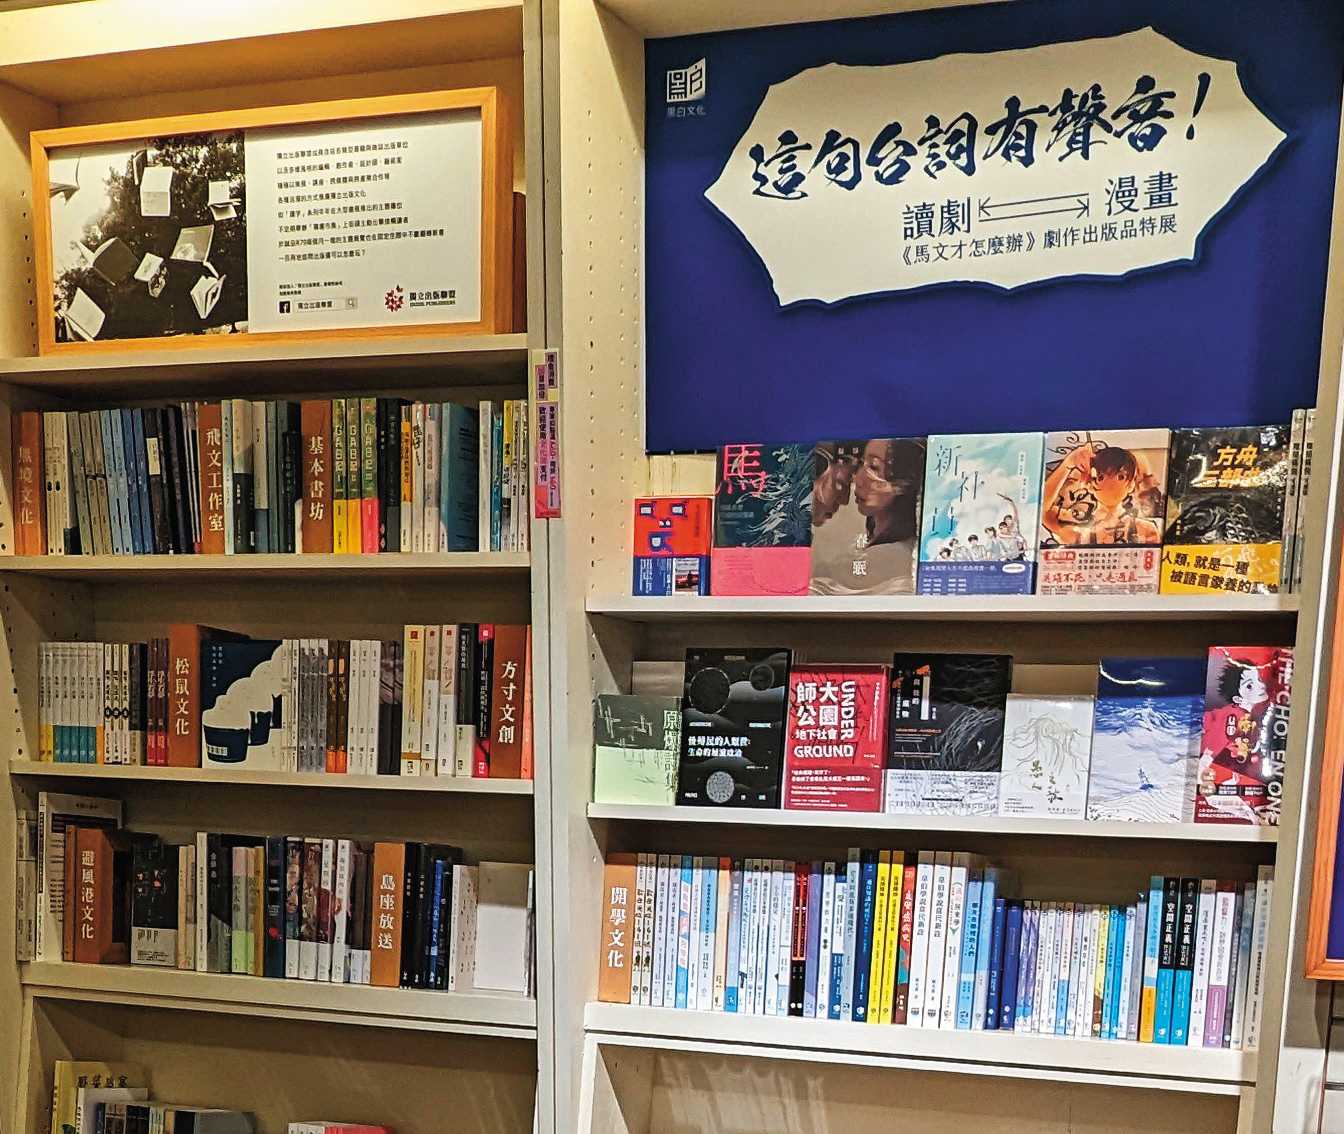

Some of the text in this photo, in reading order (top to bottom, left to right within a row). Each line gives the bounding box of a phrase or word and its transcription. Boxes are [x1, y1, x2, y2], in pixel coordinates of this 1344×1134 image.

[901, 196, 971, 241] 讀劇
[1104, 171, 1179, 216] 漫畫
[308, 435, 325, 521] 基本書坊
[1213, 445, 1258, 466] 方舟
[174, 658, 191, 736] 松鼠文化
[497, 660, 516, 745] 方寸文創
[796, 681, 838, 703] 師大
[796, 705, 838, 726] 公園
[840, 681, 855, 740] UNDER
[793, 744, 855, 758] GROUND
[796, 728, 838, 740] 地下社會
[81, 850, 96, 940] 避風港文化
[377, 873, 396, 949] 島座放送
[607, 886, 628, 968] 開學文化
